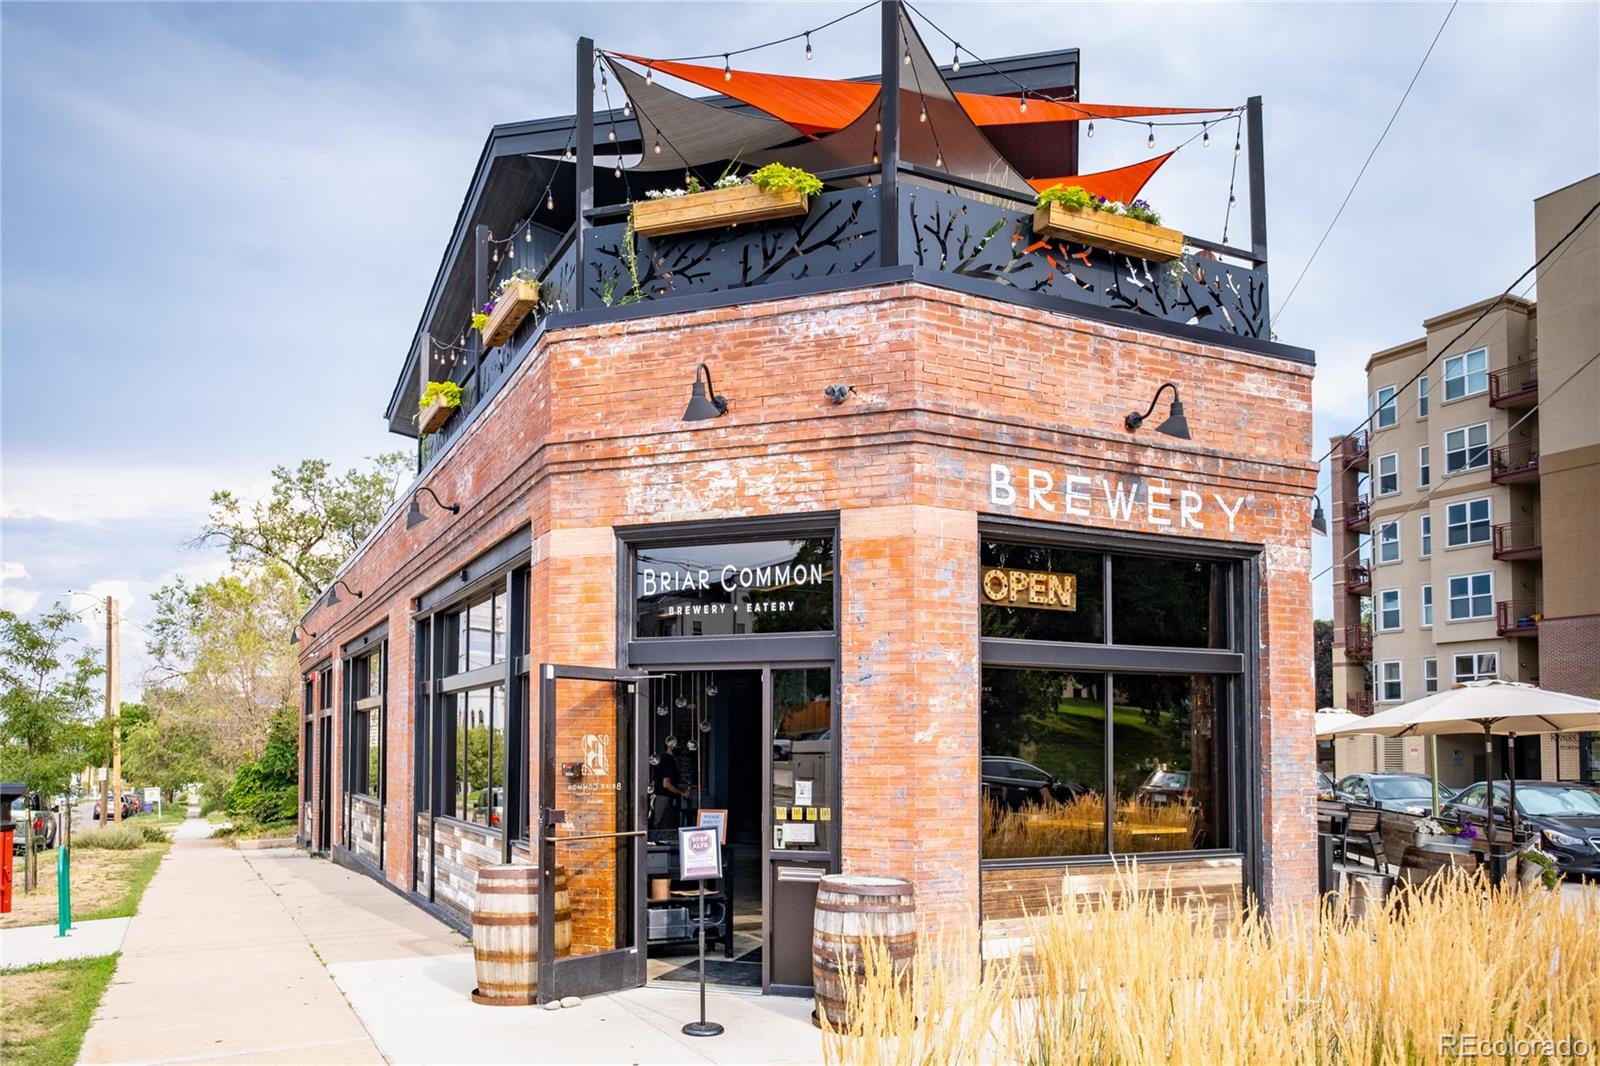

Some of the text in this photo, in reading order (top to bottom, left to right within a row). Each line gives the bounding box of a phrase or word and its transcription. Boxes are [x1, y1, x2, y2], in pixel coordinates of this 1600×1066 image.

[990, 463, 1245, 533] BREWERY
[643, 564, 822, 596] BRIAR COMMON
[983, 569, 1072, 607] OPEN
[668, 604, 726, 616] BREWERY
[746, 601, 795, 613] EATERY
